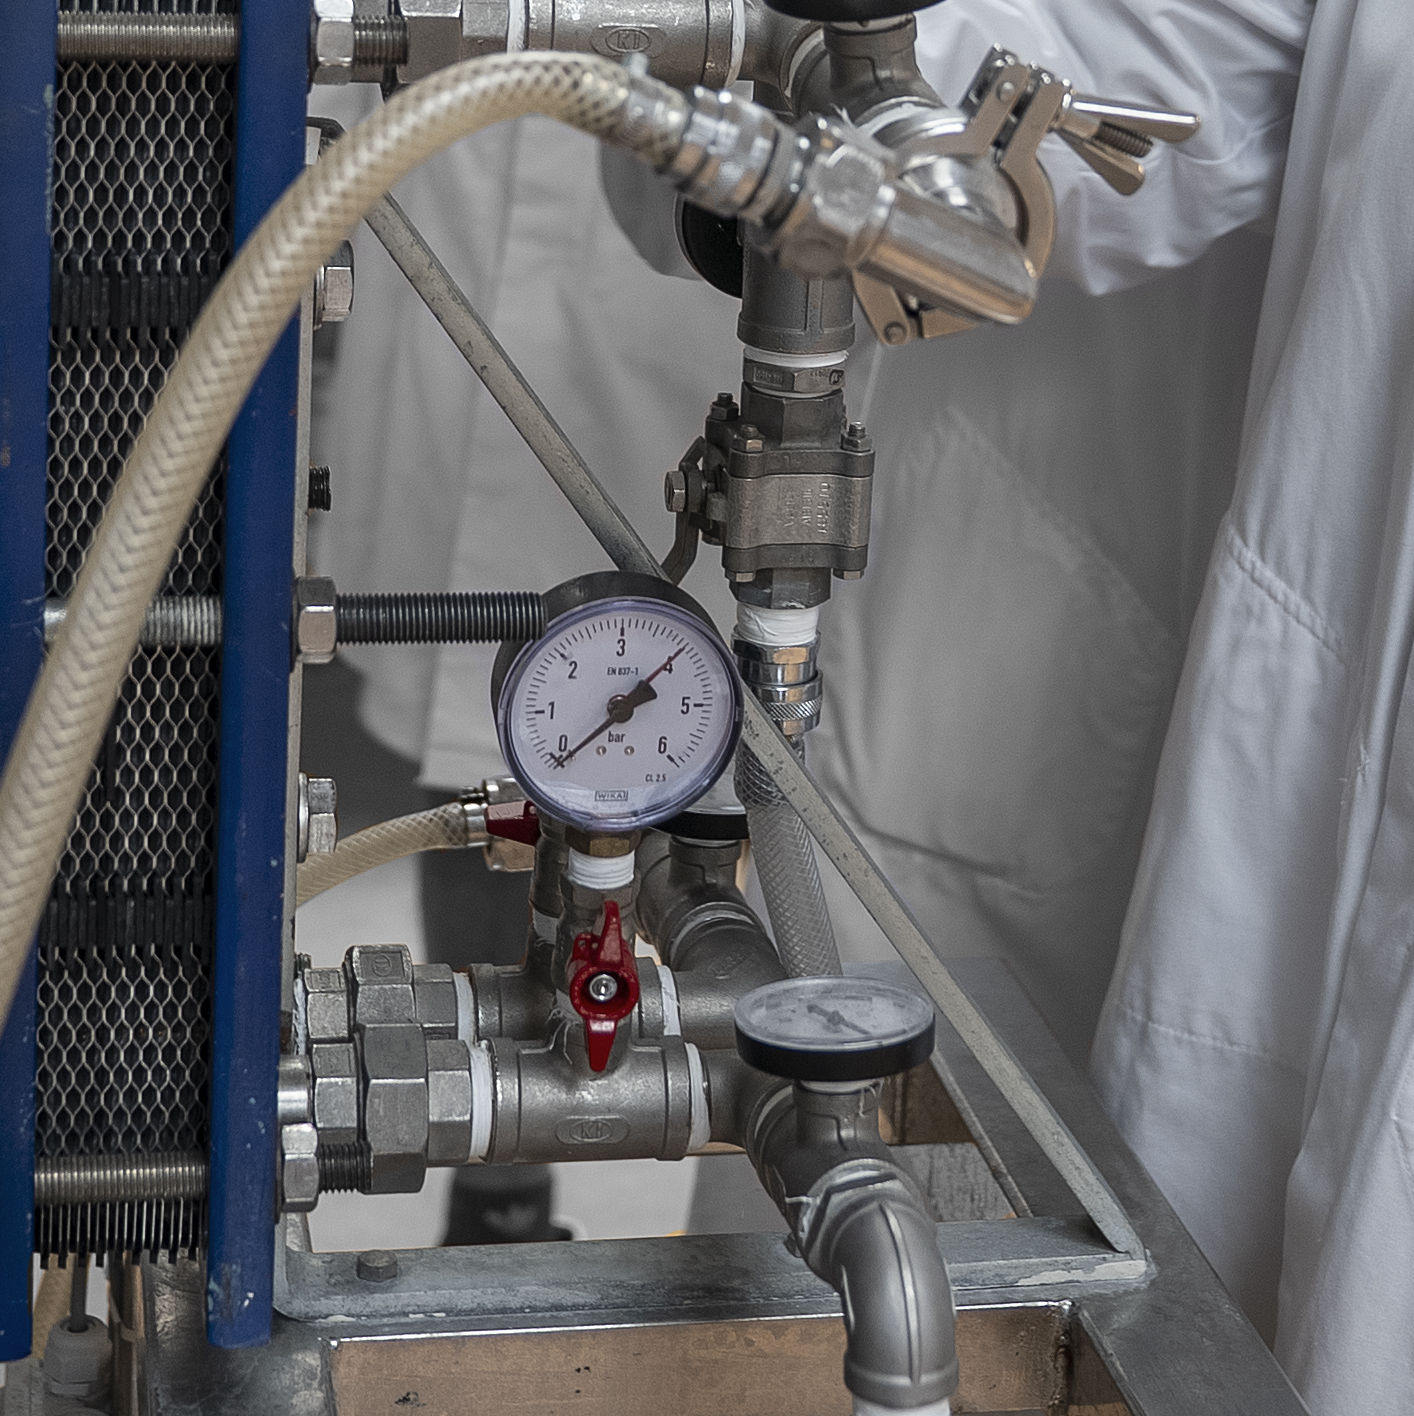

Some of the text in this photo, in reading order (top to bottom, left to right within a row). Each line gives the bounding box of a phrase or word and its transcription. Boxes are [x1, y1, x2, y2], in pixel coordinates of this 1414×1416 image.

[616, 638, 626, 657] 3
[568, 661, 578, 679] 2
[607, 667, 639, 676] EN 837-1
[662, 655, 674, 675] 4
[548, 701, 555, 720] 1
[680, 696, 691, 715] 5
[558, 734, 568, 753] 0
[607, 731, 626, 743] bar
[657, 735, 667, 754] 6
[645, 773, 667, 783] CL 2.5
